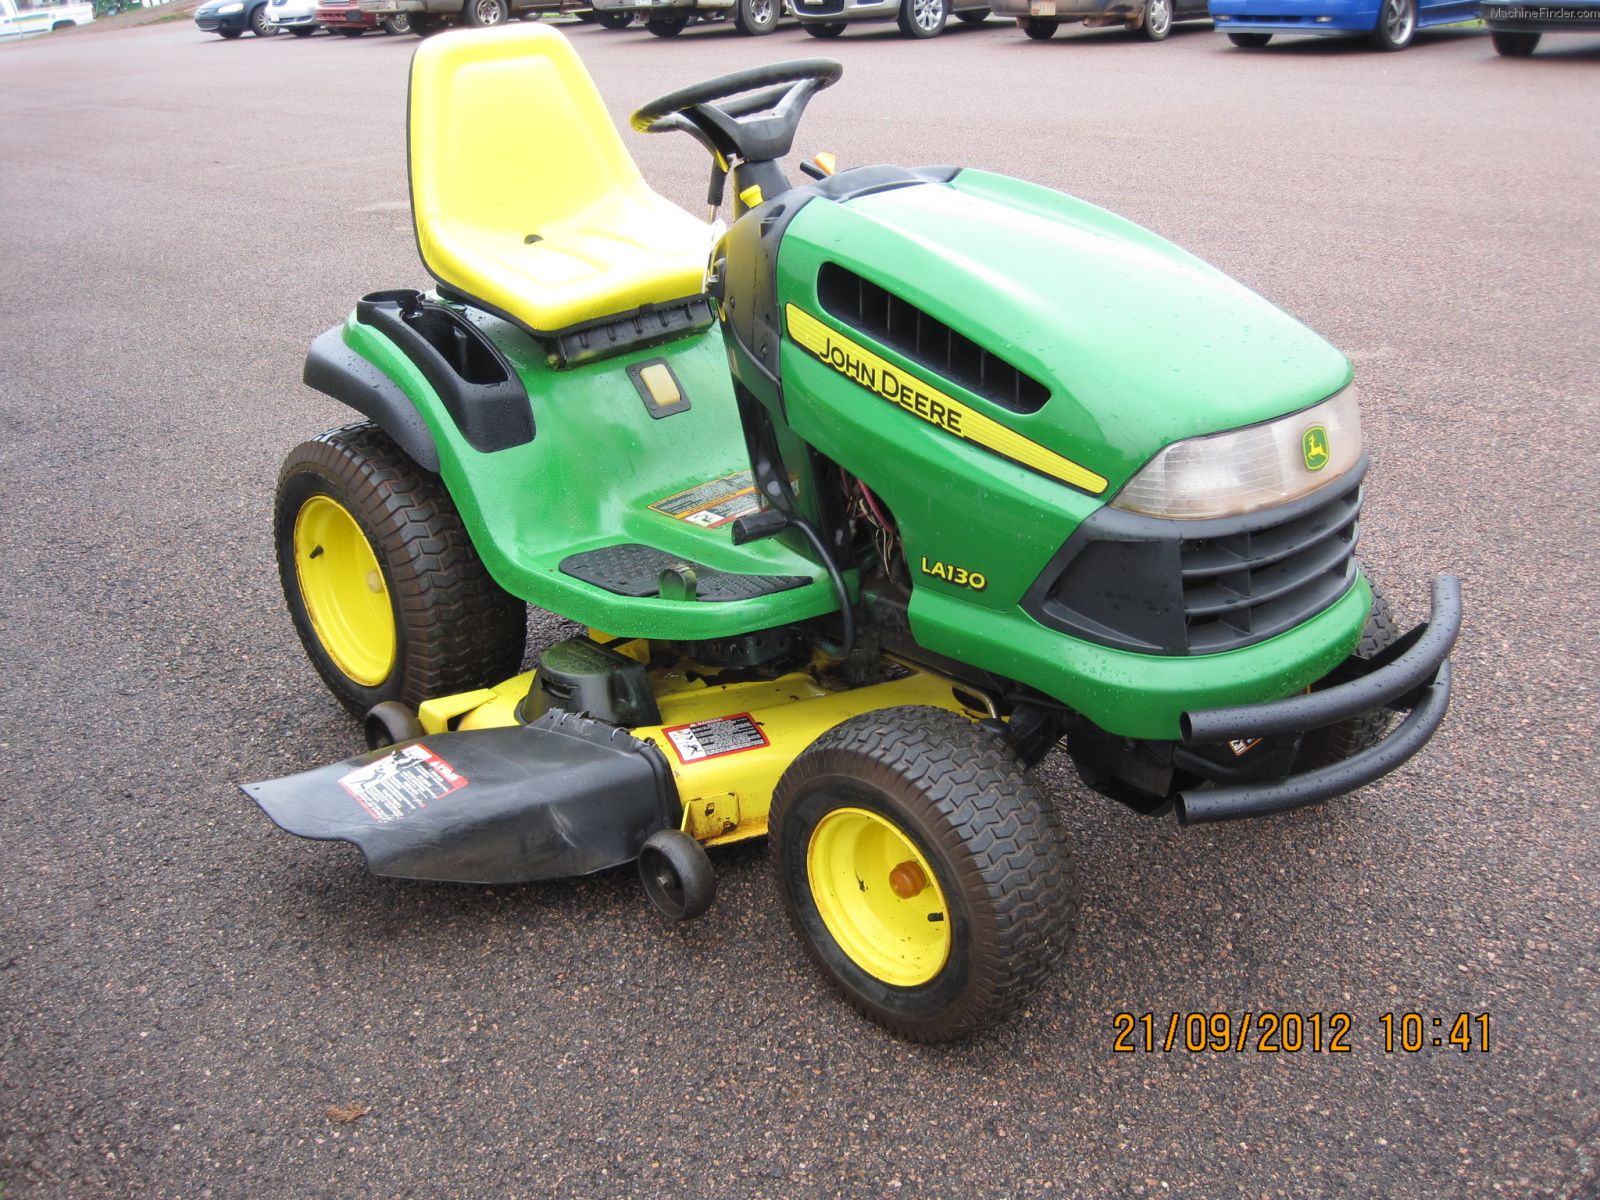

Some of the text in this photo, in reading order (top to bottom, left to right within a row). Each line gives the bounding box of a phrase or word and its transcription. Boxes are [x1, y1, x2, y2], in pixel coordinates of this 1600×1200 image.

[819, 338, 963, 433] JOHN DEERE
[921, 556, 986, 589] LA130
